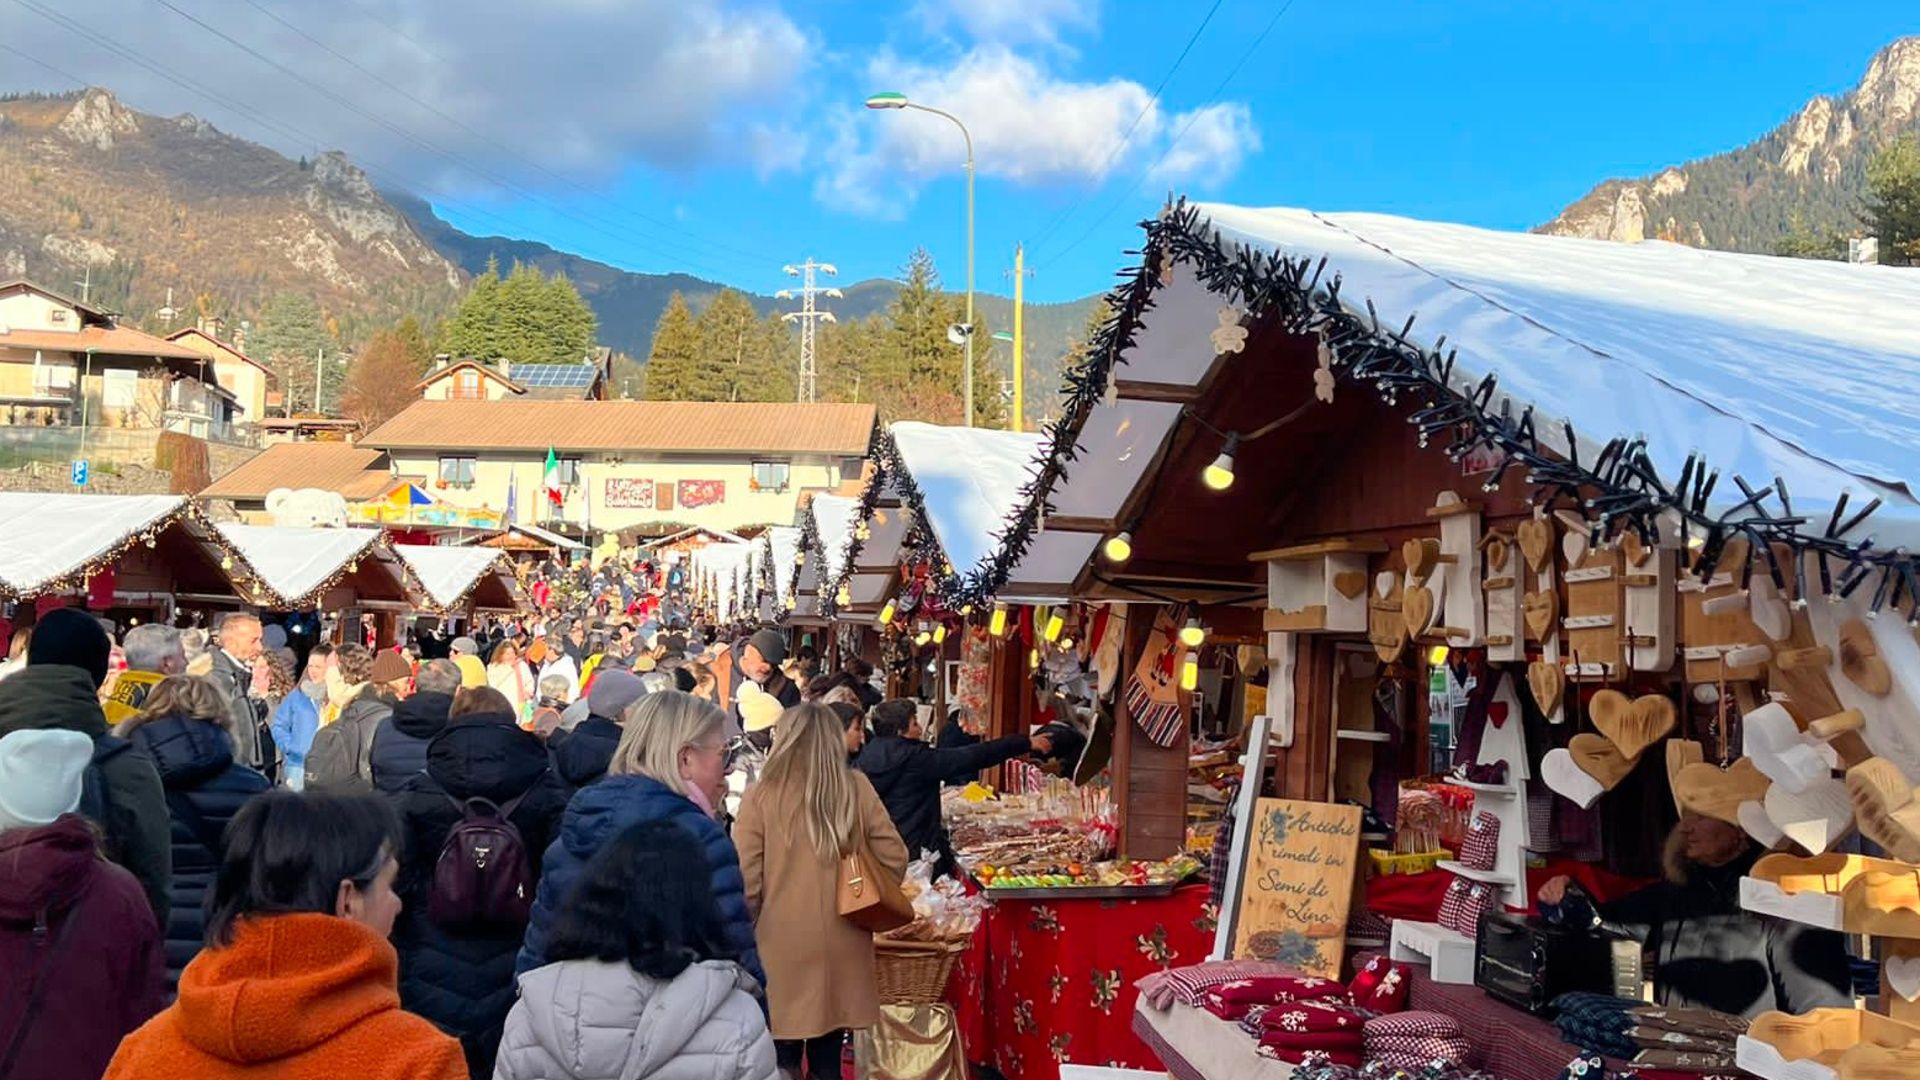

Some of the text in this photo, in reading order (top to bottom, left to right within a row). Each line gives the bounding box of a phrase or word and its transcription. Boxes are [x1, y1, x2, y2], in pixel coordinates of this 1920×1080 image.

[1288, 811, 1355, 835] Antichi
[1272, 847, 1345, 866] rimedi in
[1258, 868, 1328, 896] Semi di
[1286, 898, 1330, 923] Lino
